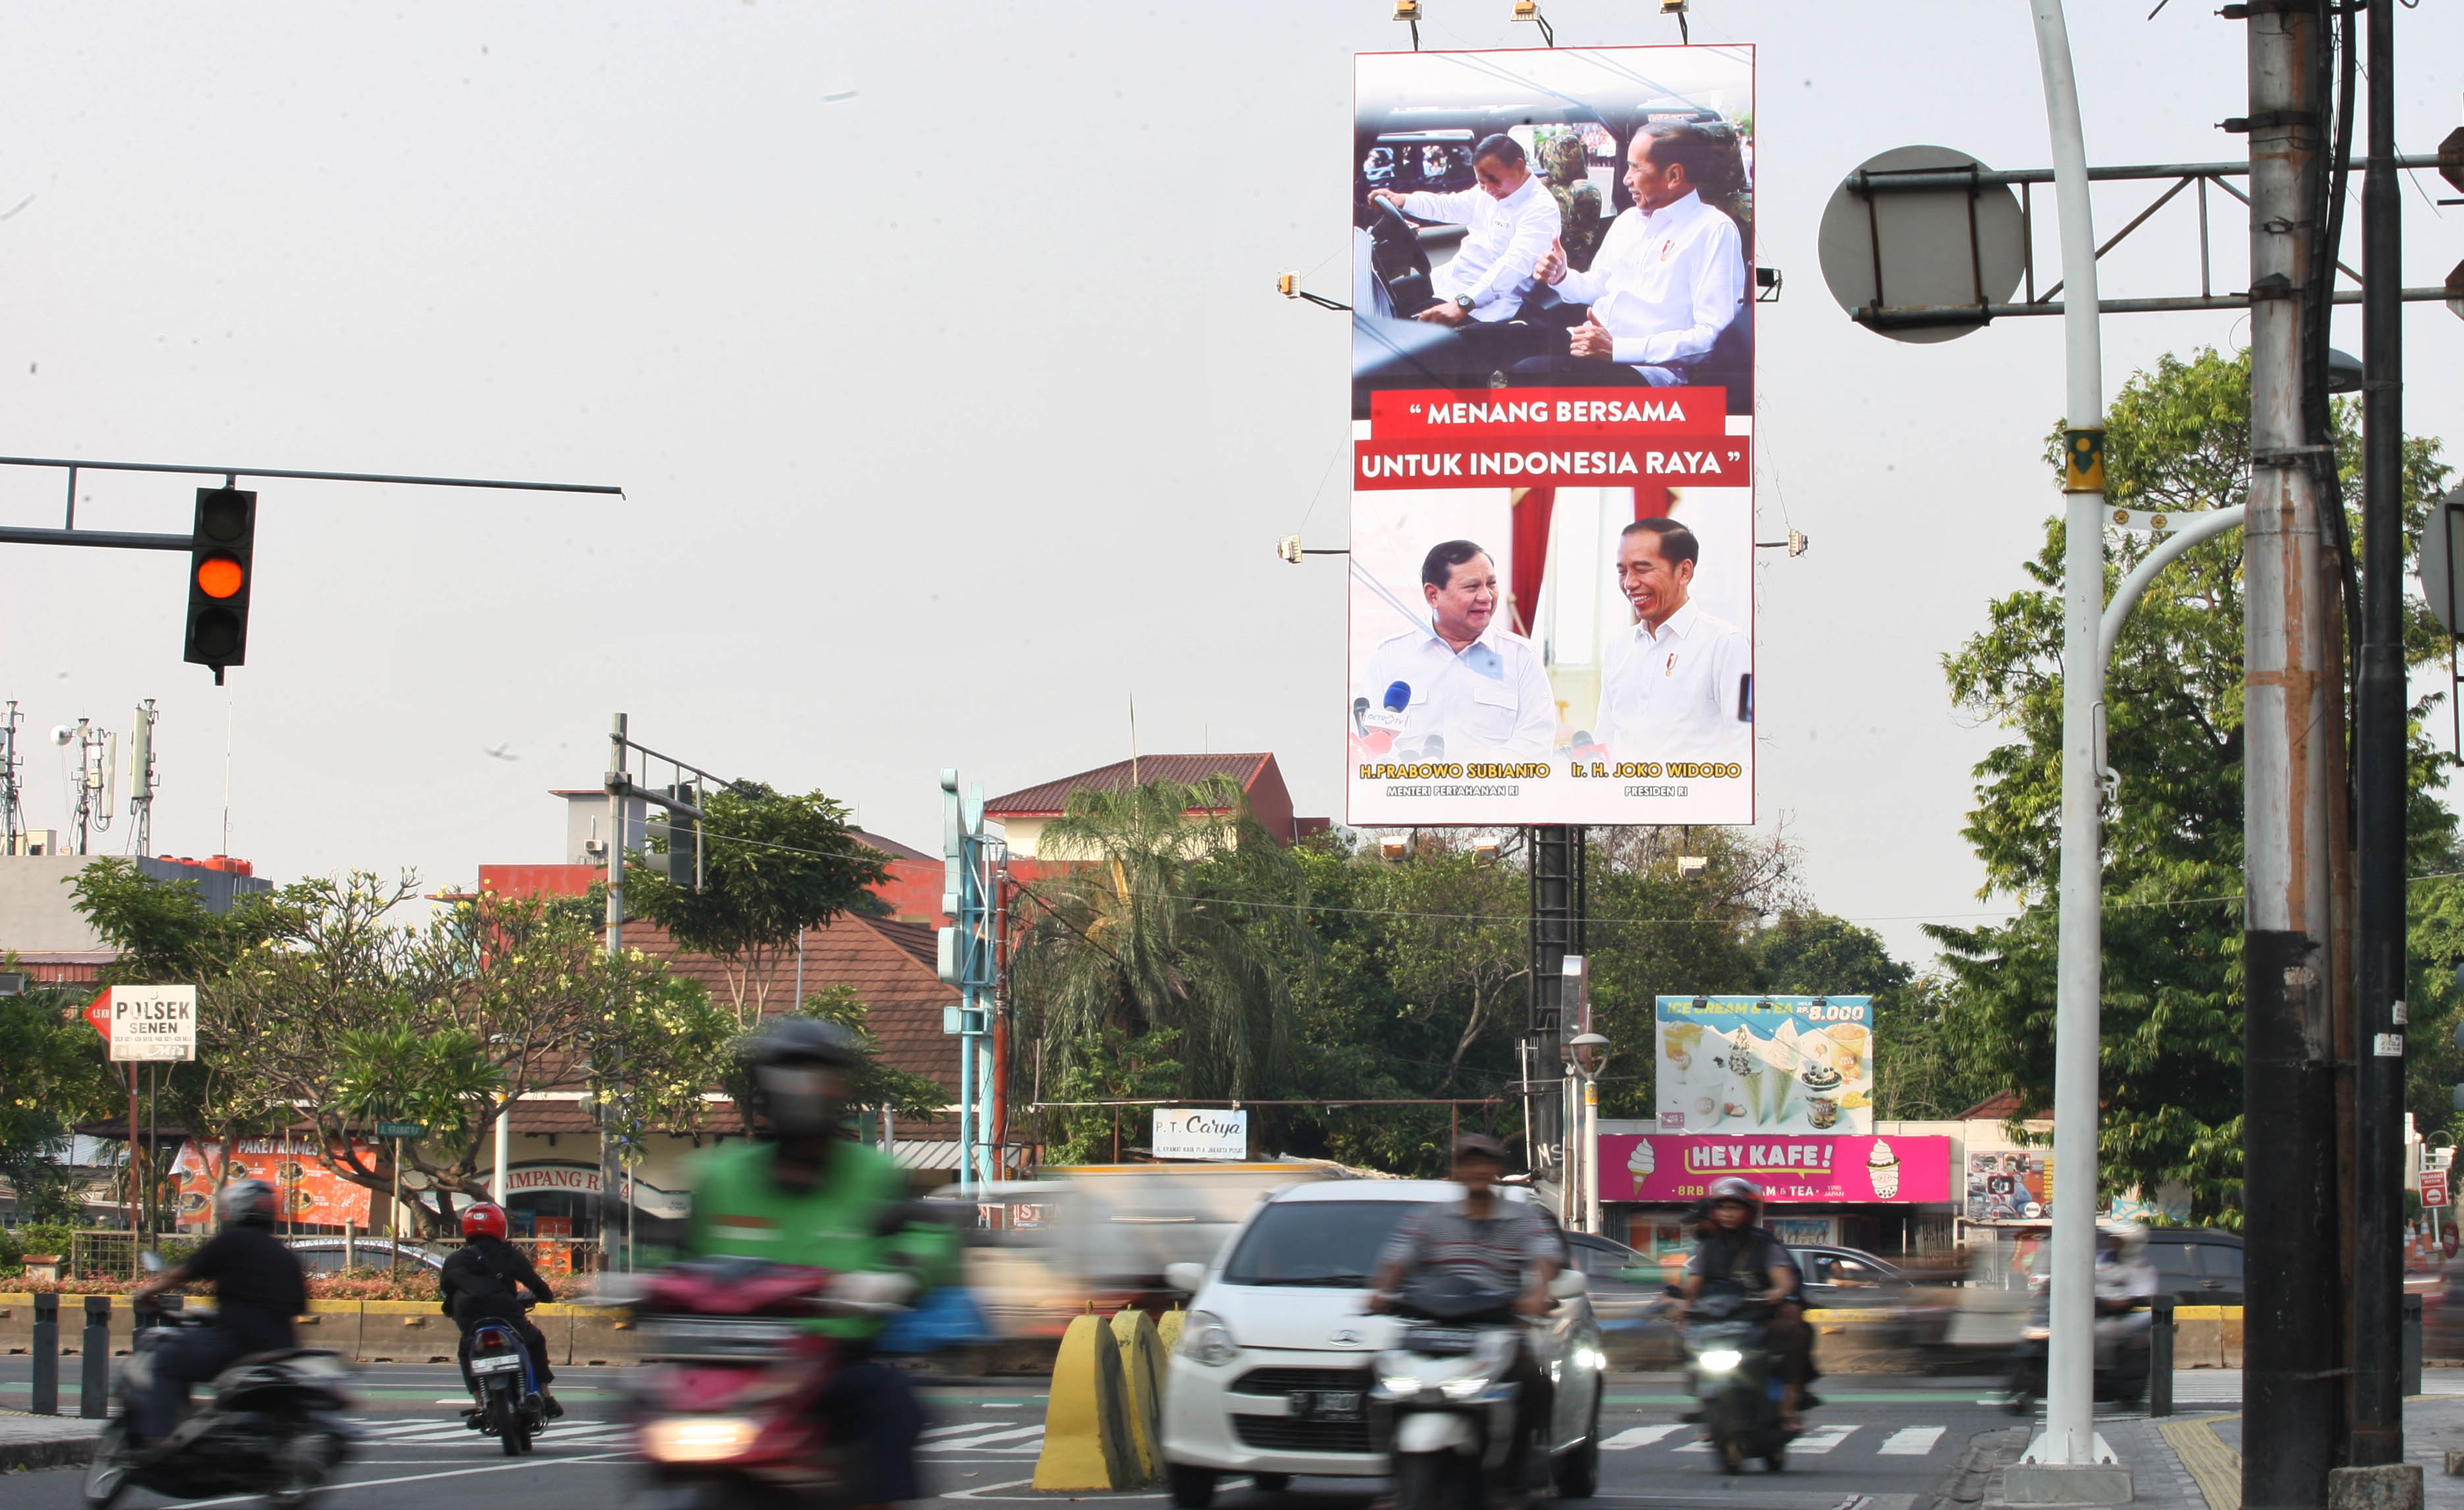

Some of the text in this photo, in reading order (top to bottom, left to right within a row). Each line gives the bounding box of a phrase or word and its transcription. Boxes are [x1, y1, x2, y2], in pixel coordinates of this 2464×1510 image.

[1427, 401, 1548, 424] MENANG
[1556, 401, 1686, 422] BERSAMA
[1362, 453, 1462, 478] UNTUK
[1470, 451, 1639, 475] INDONESIA
[1646, 451, 1722, 474] RAYA
[1467, 763, 1550, 779] SUBIANTO
[1592, 763, 1609, 778] H.
[1613, 763, 1662, 779] JOKO
[1666, 762, 1742, 779] WIDODO
[1386, 785, 1519, 797] MENTERI PERTAHANAN RI
[1624, 785, 1688, 797] PRESIDEN RI
[101, 1009, 110, 1019] KM
[1668, 1002, 1691, 1014] ICE
[1764, 1002, 1793, 1015] TEA
[1809, 1005, 1865, 1021] 8.000
[129, 1022, 178, 1034] SENEN
[1186, 1115, 1242, 1138] Carya
[238, 1139, 275, 1154] PAKET
[1692, 1145, 1744, 1167] HEY
[506, 1171, 582, 1190] IMPANG
[1678, 1186, 1704, 1196] 8RB
[1789, 1185, 1815, 1196] TEA
